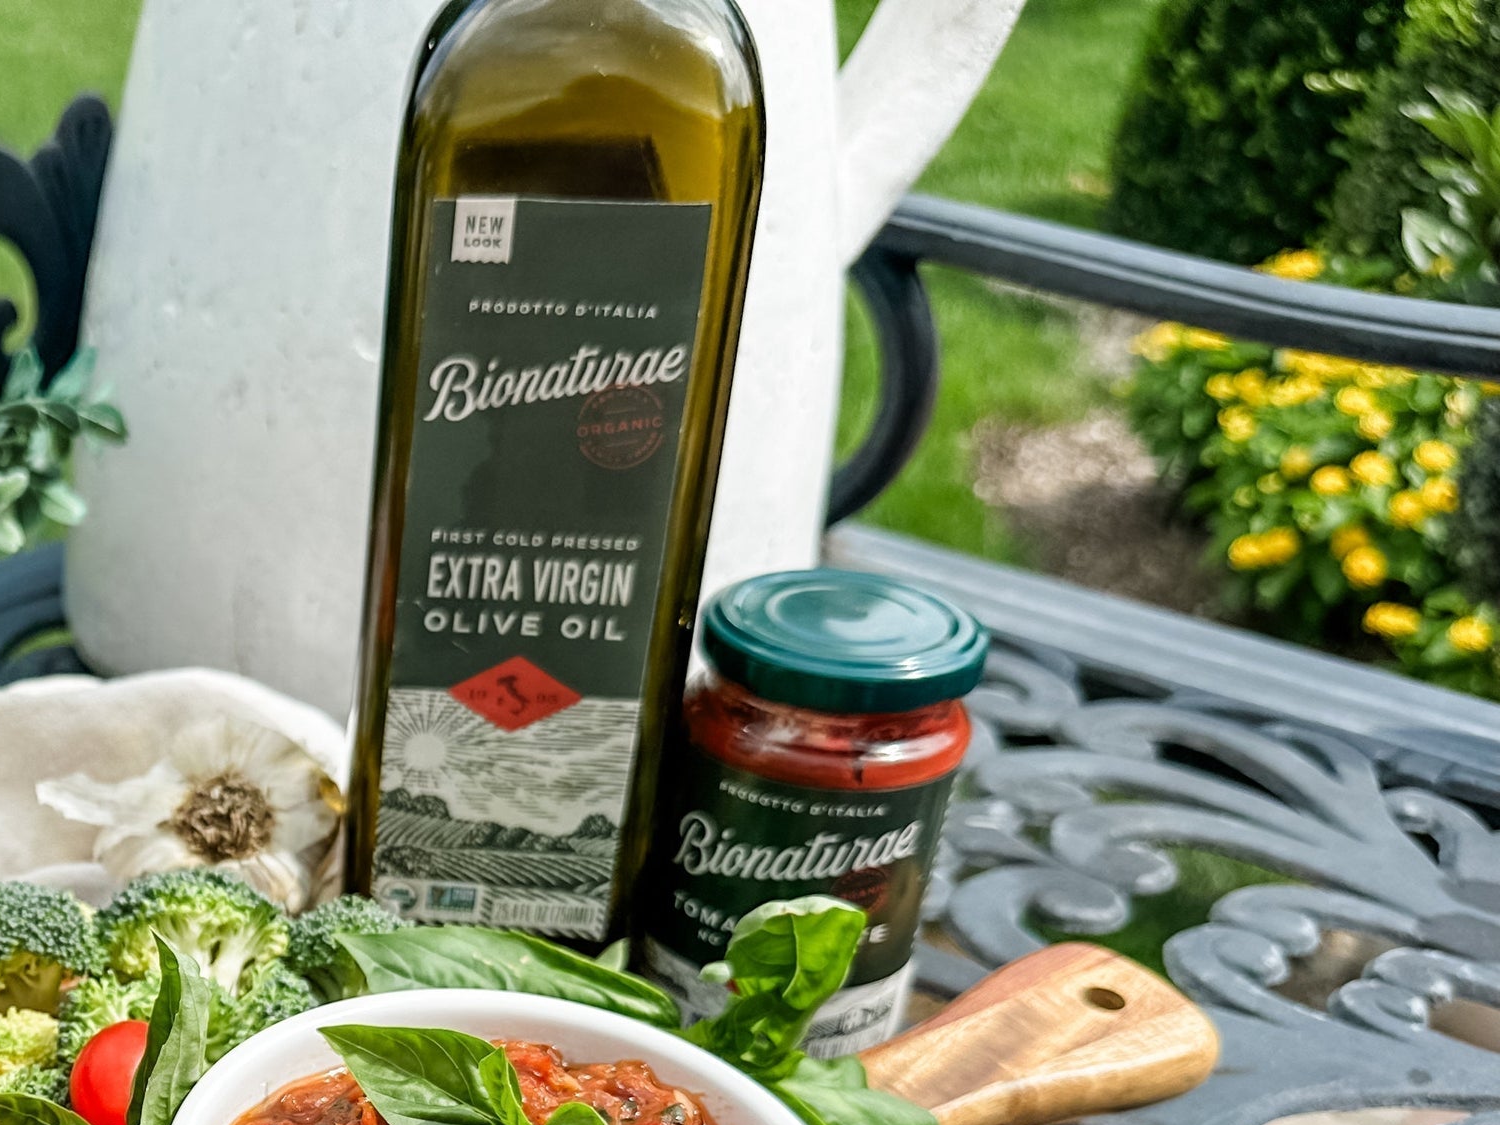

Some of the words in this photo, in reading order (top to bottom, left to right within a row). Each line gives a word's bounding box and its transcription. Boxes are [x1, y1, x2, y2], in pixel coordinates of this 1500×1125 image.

[465, 215, 504, 234] NEW
[463, 237, 503, 249] LOOK
[468, 297, 568, 316] PRODOTTO
[575, 303, 660, 320] D'ITALIA
[423, 344, 688, 422] Bionaturae
[577, 416, 664, 438] ORGANIC
[430, 529, 486, 545] FIRST
[493, 532, 545, 548] COLD
[551, 533, 642, 551] PRESSED
[426, 553, 520, 602] EXTRA
[533, 557, 636, 608] VIRGIN
[423, 607, 542, 637] OLIVE
[560, 613, 628, 641] OIL
[672, 810, 924, 881] Bionaturae
[673, 888, 737, 933] TOMA
